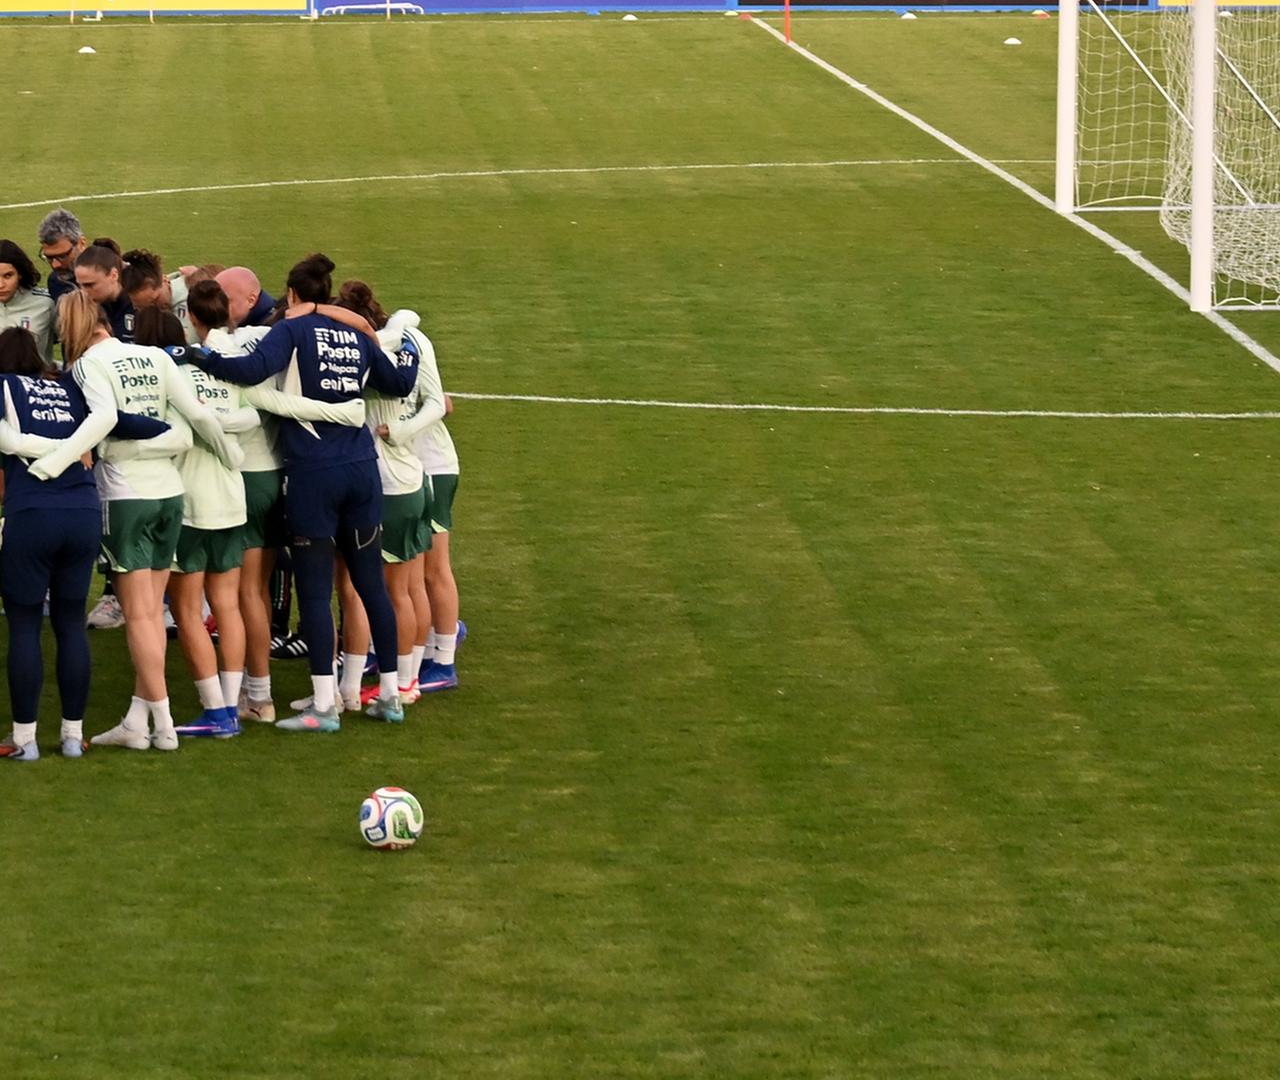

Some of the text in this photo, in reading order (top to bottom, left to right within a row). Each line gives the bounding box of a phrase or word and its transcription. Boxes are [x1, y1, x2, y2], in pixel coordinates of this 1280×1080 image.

[330, 329, 359, 345] TIM
[317, 341, 361, 360] Poste
[126, 357, 154, 369] TIM
[119, 374, 159, 389] Poste
[320, 376, 342, 391] eni
[31, 409, 55, 422] eni
